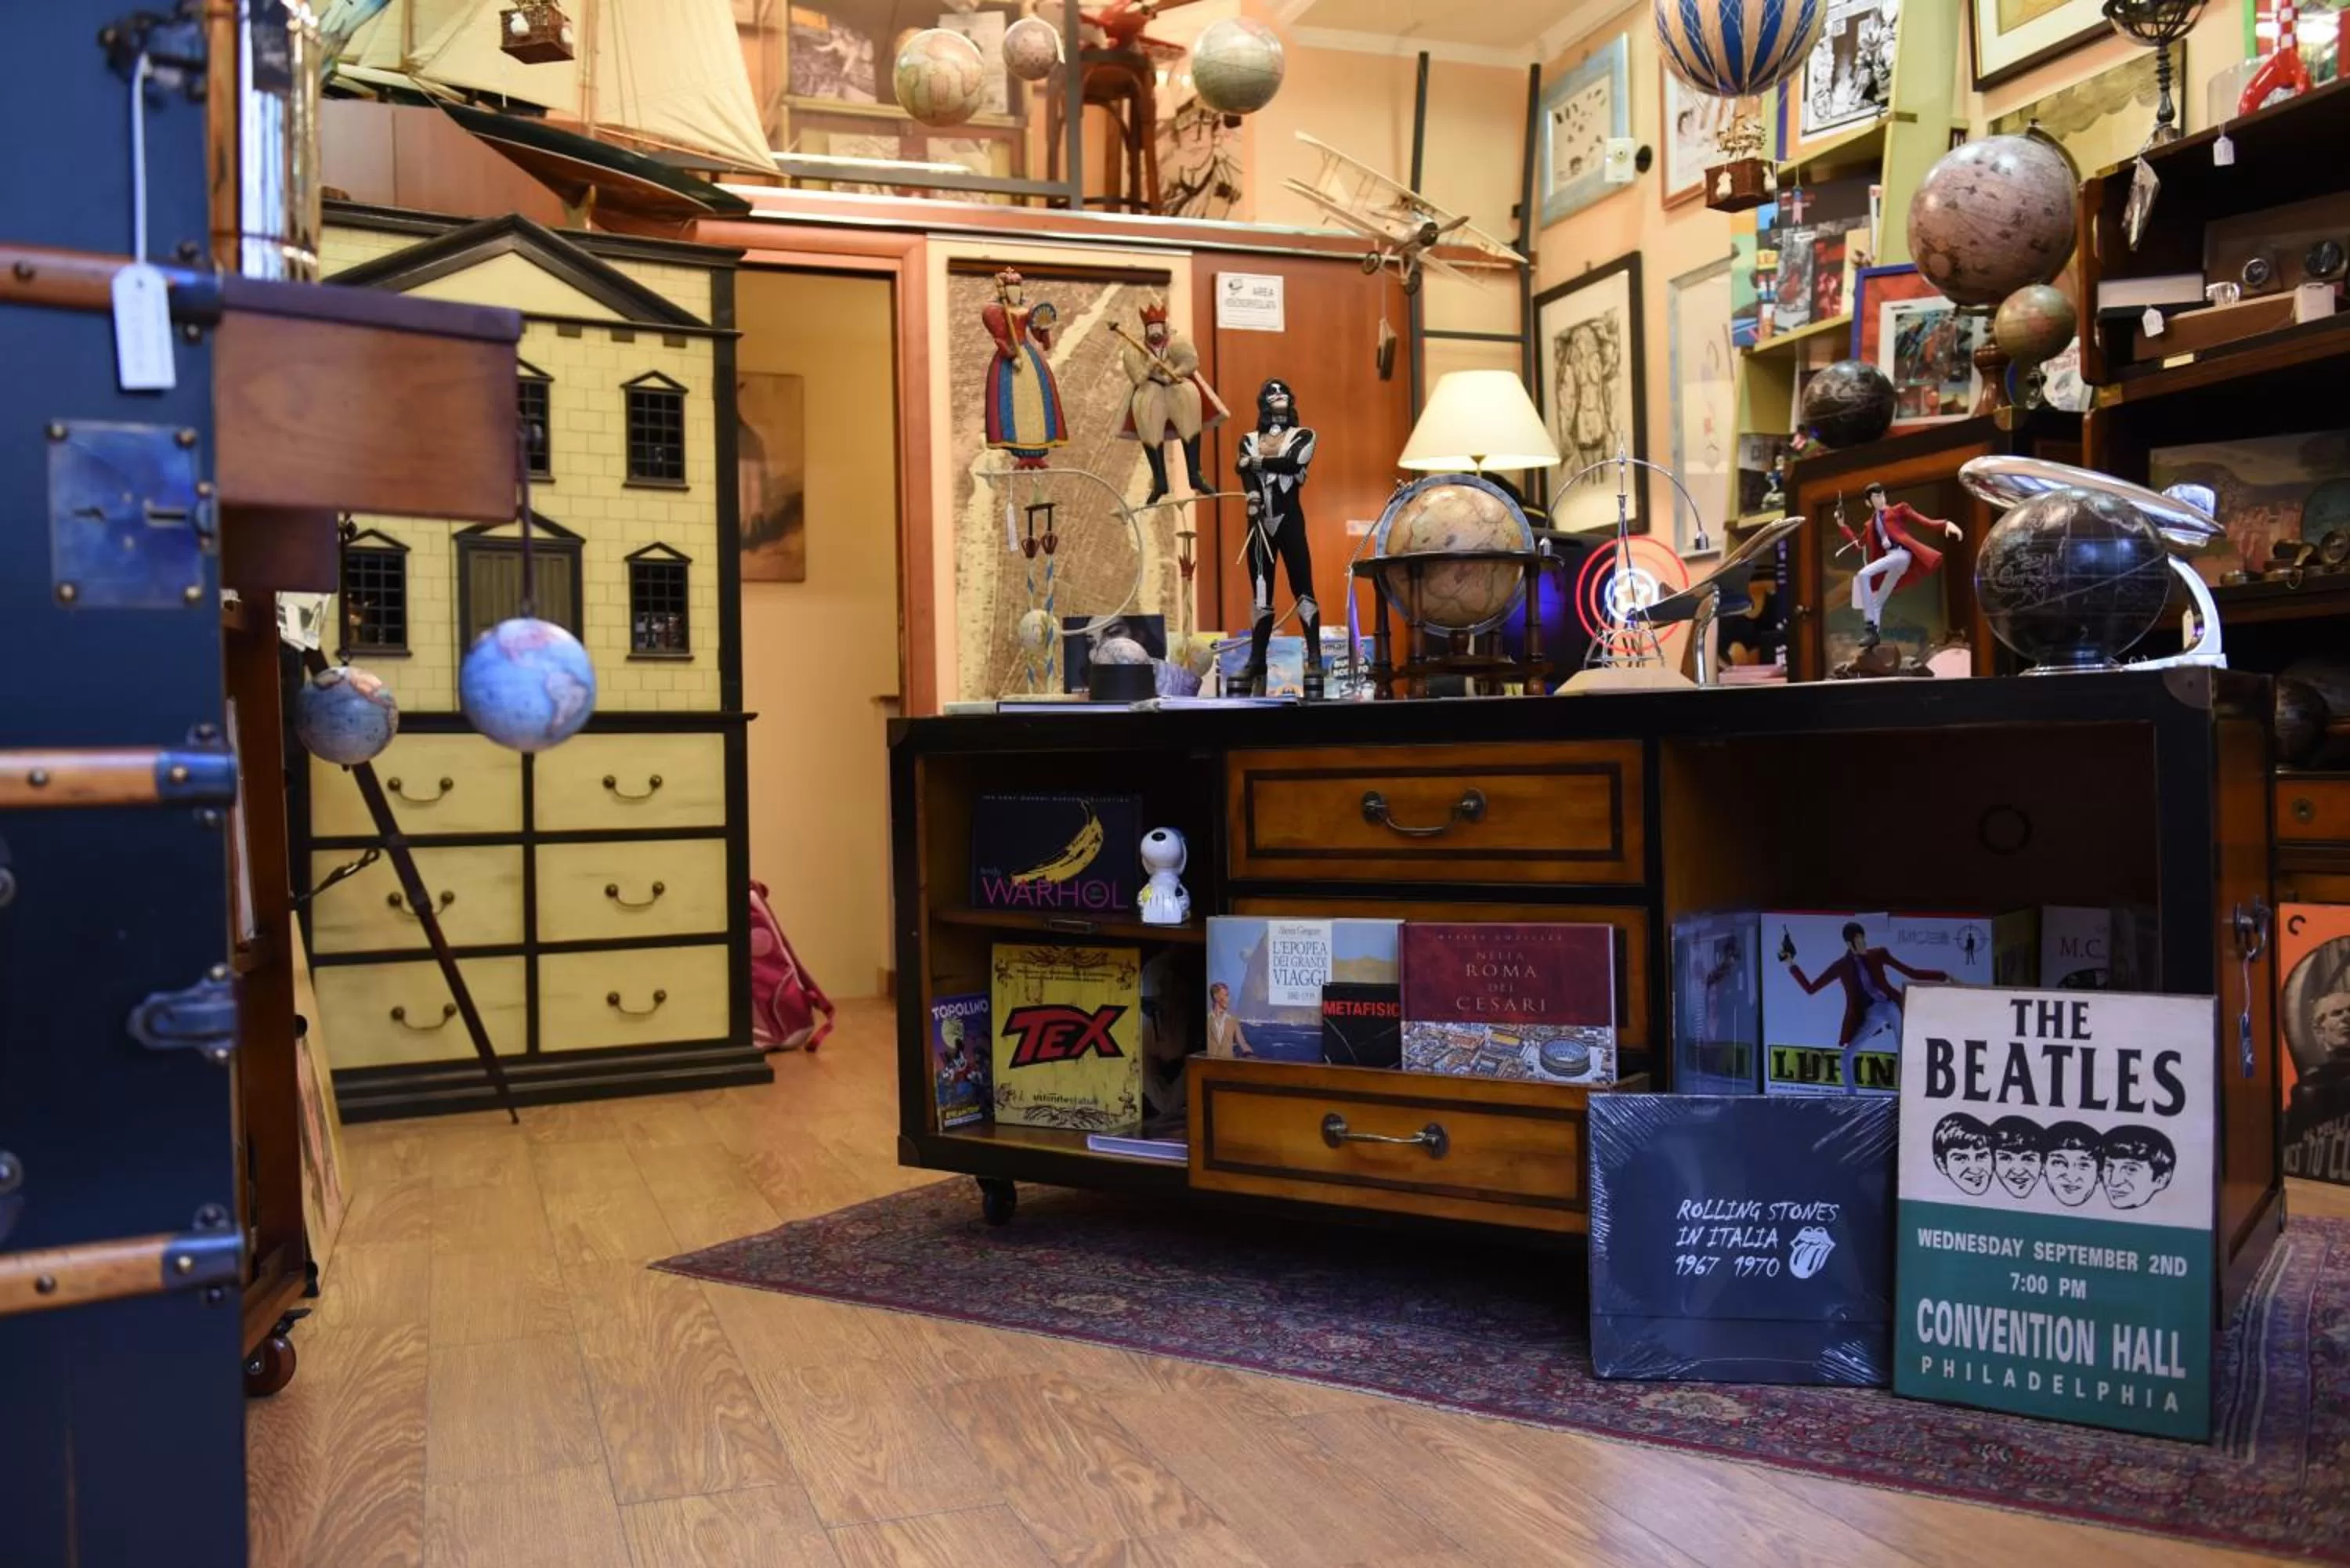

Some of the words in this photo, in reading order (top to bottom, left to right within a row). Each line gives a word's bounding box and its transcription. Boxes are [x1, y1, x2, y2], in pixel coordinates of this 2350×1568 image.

[982, 876, 1129, 909] WARHOL
[1273, 940, 1328, 956] L'EPOPEA
[1292, 956, 1327, 968] GRANDI
[1466, 963, 1537, 978] ROMA
[1273, 968, 1329, 987] VIAGGI
[1488, 982, 1513, 992] DEI
[931, 999, 989, 1020] TOPOLINO
[1455, 996, 1546, 1013] CESARI
[2010, 998, 2092, 1041] THE
[1002, 1004, 1129, 1068] TEX
[1924, 1037, 2187, 1117] BEATLES
[1676, 1199, 1762, 1222] ROLLING
[1769, 1201, 1840, 1223] STONES
[1676, 1227, 1701, 1247] IN
[1707, 1227, 1778, 1249] ITALIA
[1918, 1227, 2023, 1259] WEDNESDAY
[2034, 1241, 2138, 1272] SEPTEMBER
[2149, 1255, 2188, 1277] 2ND
[1676, 1254, 1721, 1277] 1967
[1734, 1255, 1781, 1277] 1970
[2009, 1272, 2048, 1295] 7:00
[2059, 1277, 2087, 1300] PM
[1917, 1297, 2095, 1367] CONVENTION
[2113, 1323, 2186, 1379] HALL
[1922, 1355, 2179, 1413] PHILADELPHIA
